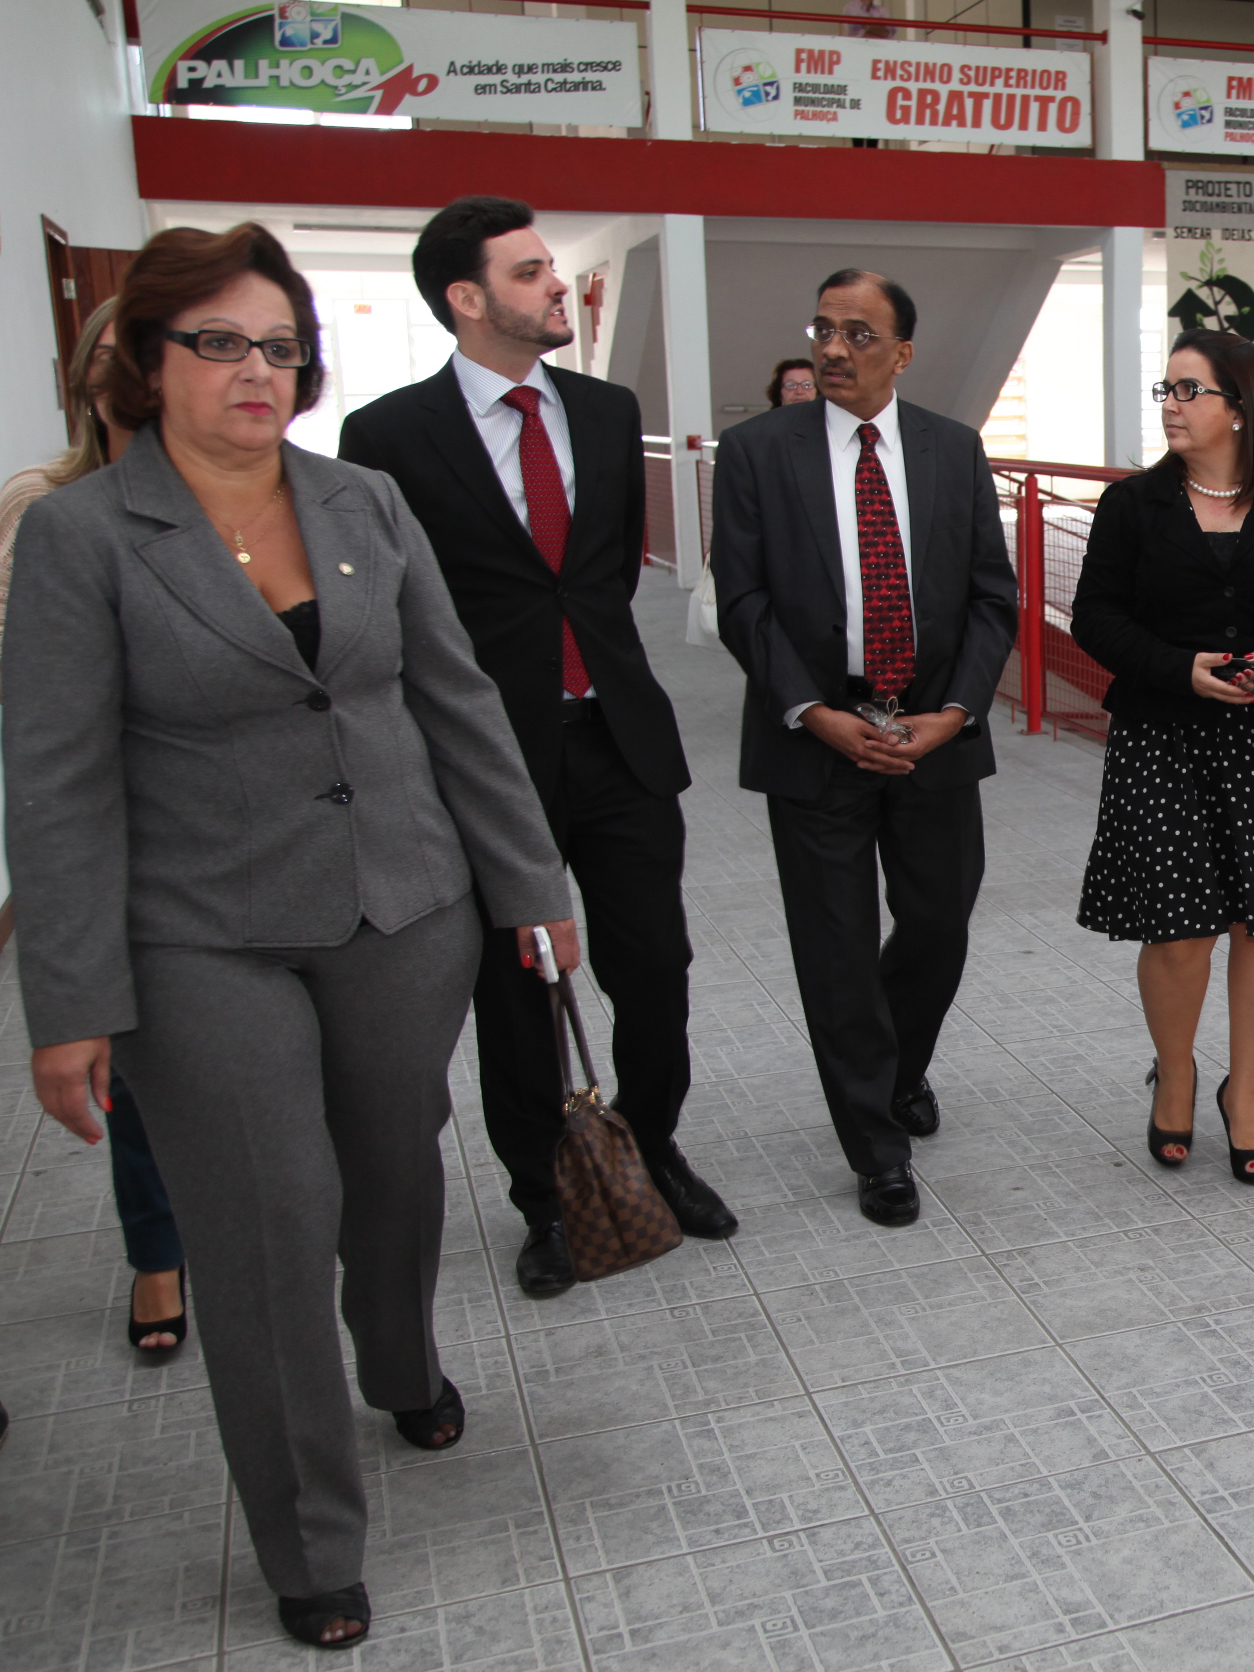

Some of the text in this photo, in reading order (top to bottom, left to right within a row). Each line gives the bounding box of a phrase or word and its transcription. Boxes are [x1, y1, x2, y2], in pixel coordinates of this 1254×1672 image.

[446, 59, 622, 78] A cidade que mais cresce
[794, 47, 842, 76] FMP
[176, 58, 382, 94] PALHOÇA
[870, 58, 1068, 92] ENSINO SUPERIOR
[474, 77, 607, 95] em Santa Catarina.
[793, 82, 848, 96] FACULDADE
[793, 95, 862, 110] MUNICIPAL DE
[885, 85, 1082, 135] GRATUITO
[793, 109, 839, 124] PALHOÇA
[1185, 179, 1253, 198] PROJETO
[1174, 226, 1212, 240] SEMEAR
